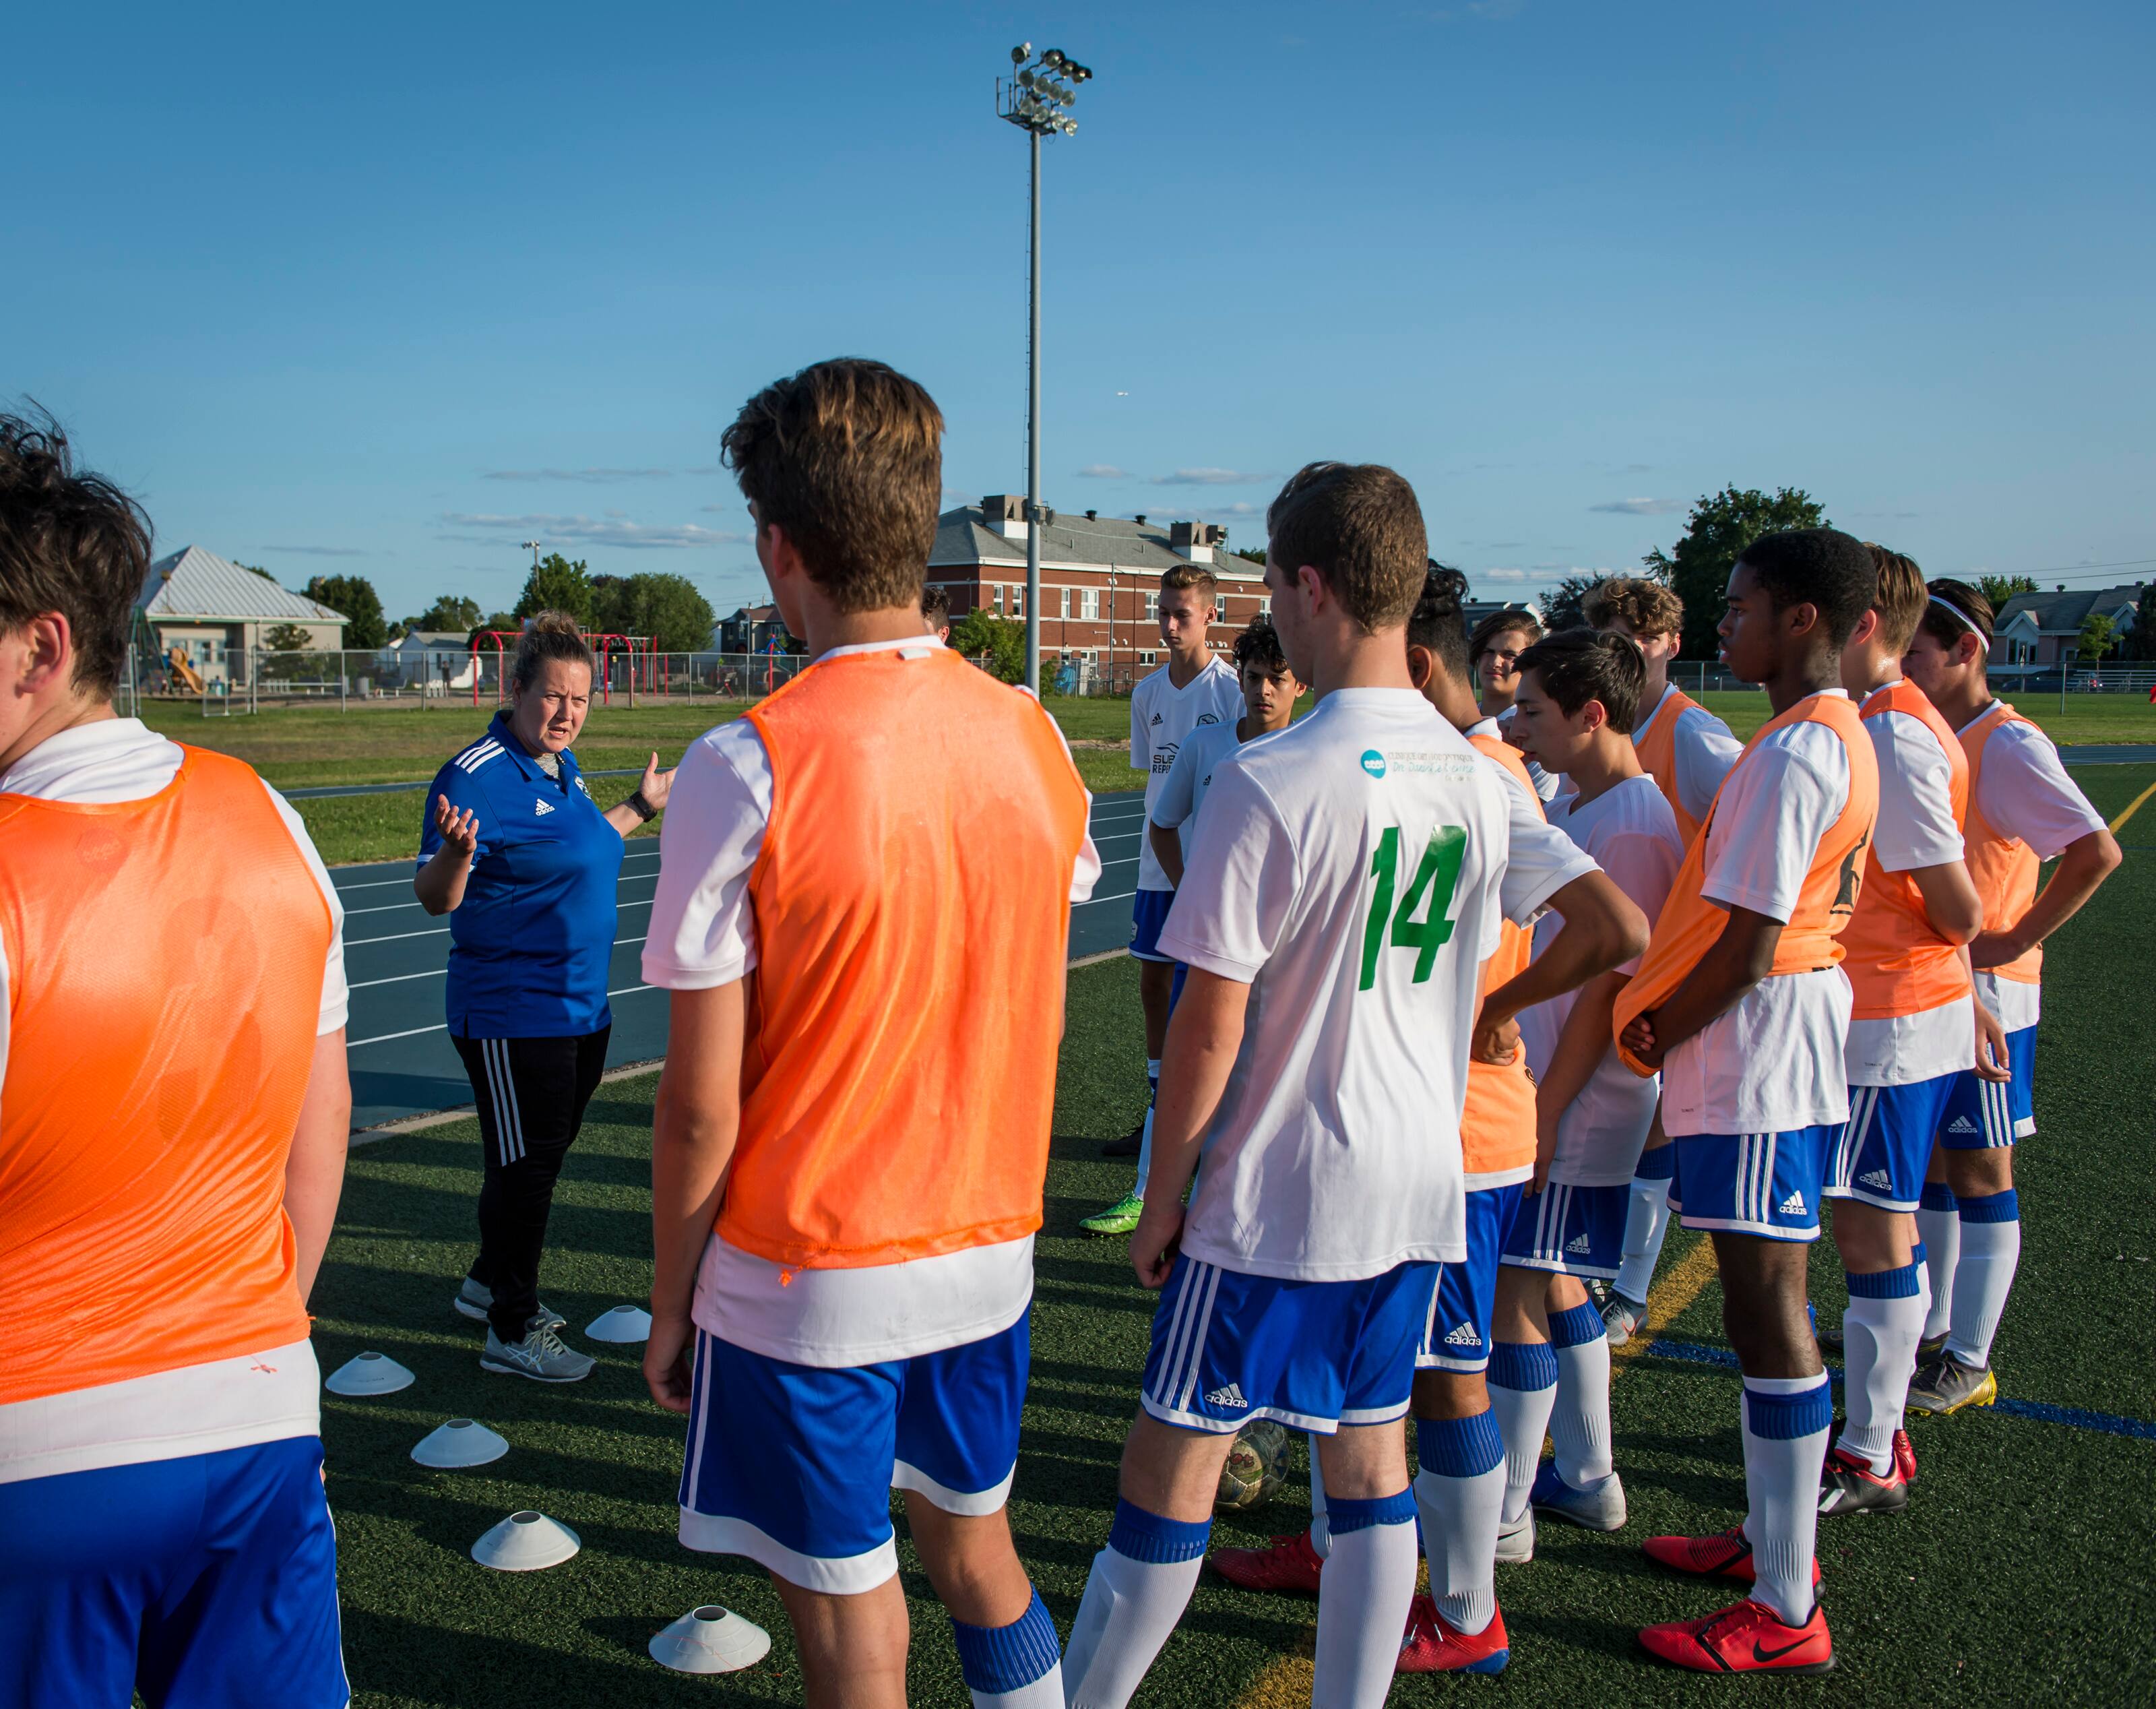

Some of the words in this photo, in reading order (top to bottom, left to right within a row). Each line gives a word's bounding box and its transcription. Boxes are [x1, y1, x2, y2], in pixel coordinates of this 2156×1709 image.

[536, 805, 555, 815] adidas
[1358, 824, 1467, 991] 14
[1860, 1175, 1892, 1191] adidas
[1779, 1205, 1807, 1215] adidas
[1566, 1244, 1591, 1255] adidas
[1445, 1335, 1482, 1346] adidas
[1205, 1394, 1248, 1408] adidas
